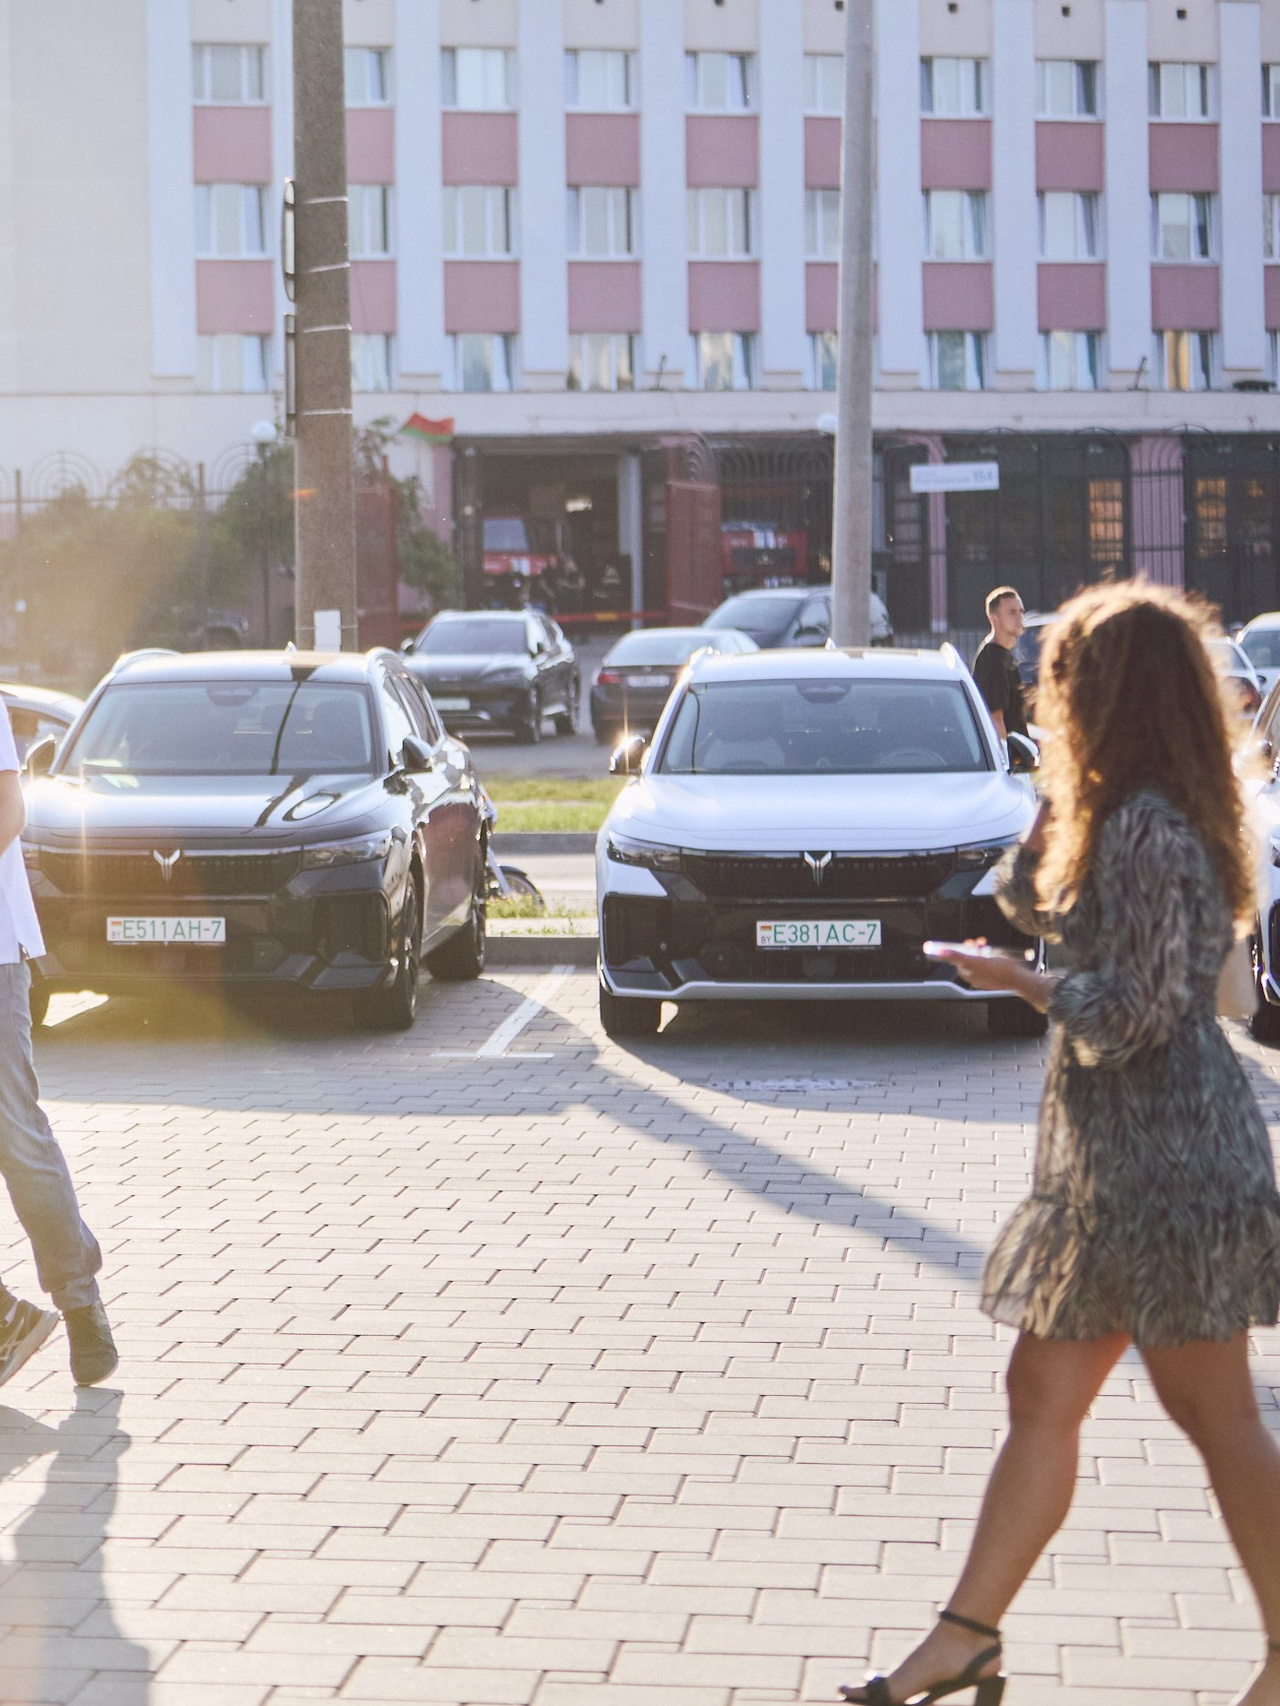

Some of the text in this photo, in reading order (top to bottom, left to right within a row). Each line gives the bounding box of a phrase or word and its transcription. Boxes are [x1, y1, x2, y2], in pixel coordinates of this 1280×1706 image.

[111, 930, 121, 940] BY
[122, 919, 222, 940] E511AH-7
[773, 923, 878, 944] E381AC-7
[761, 936, 772, 945] BY
